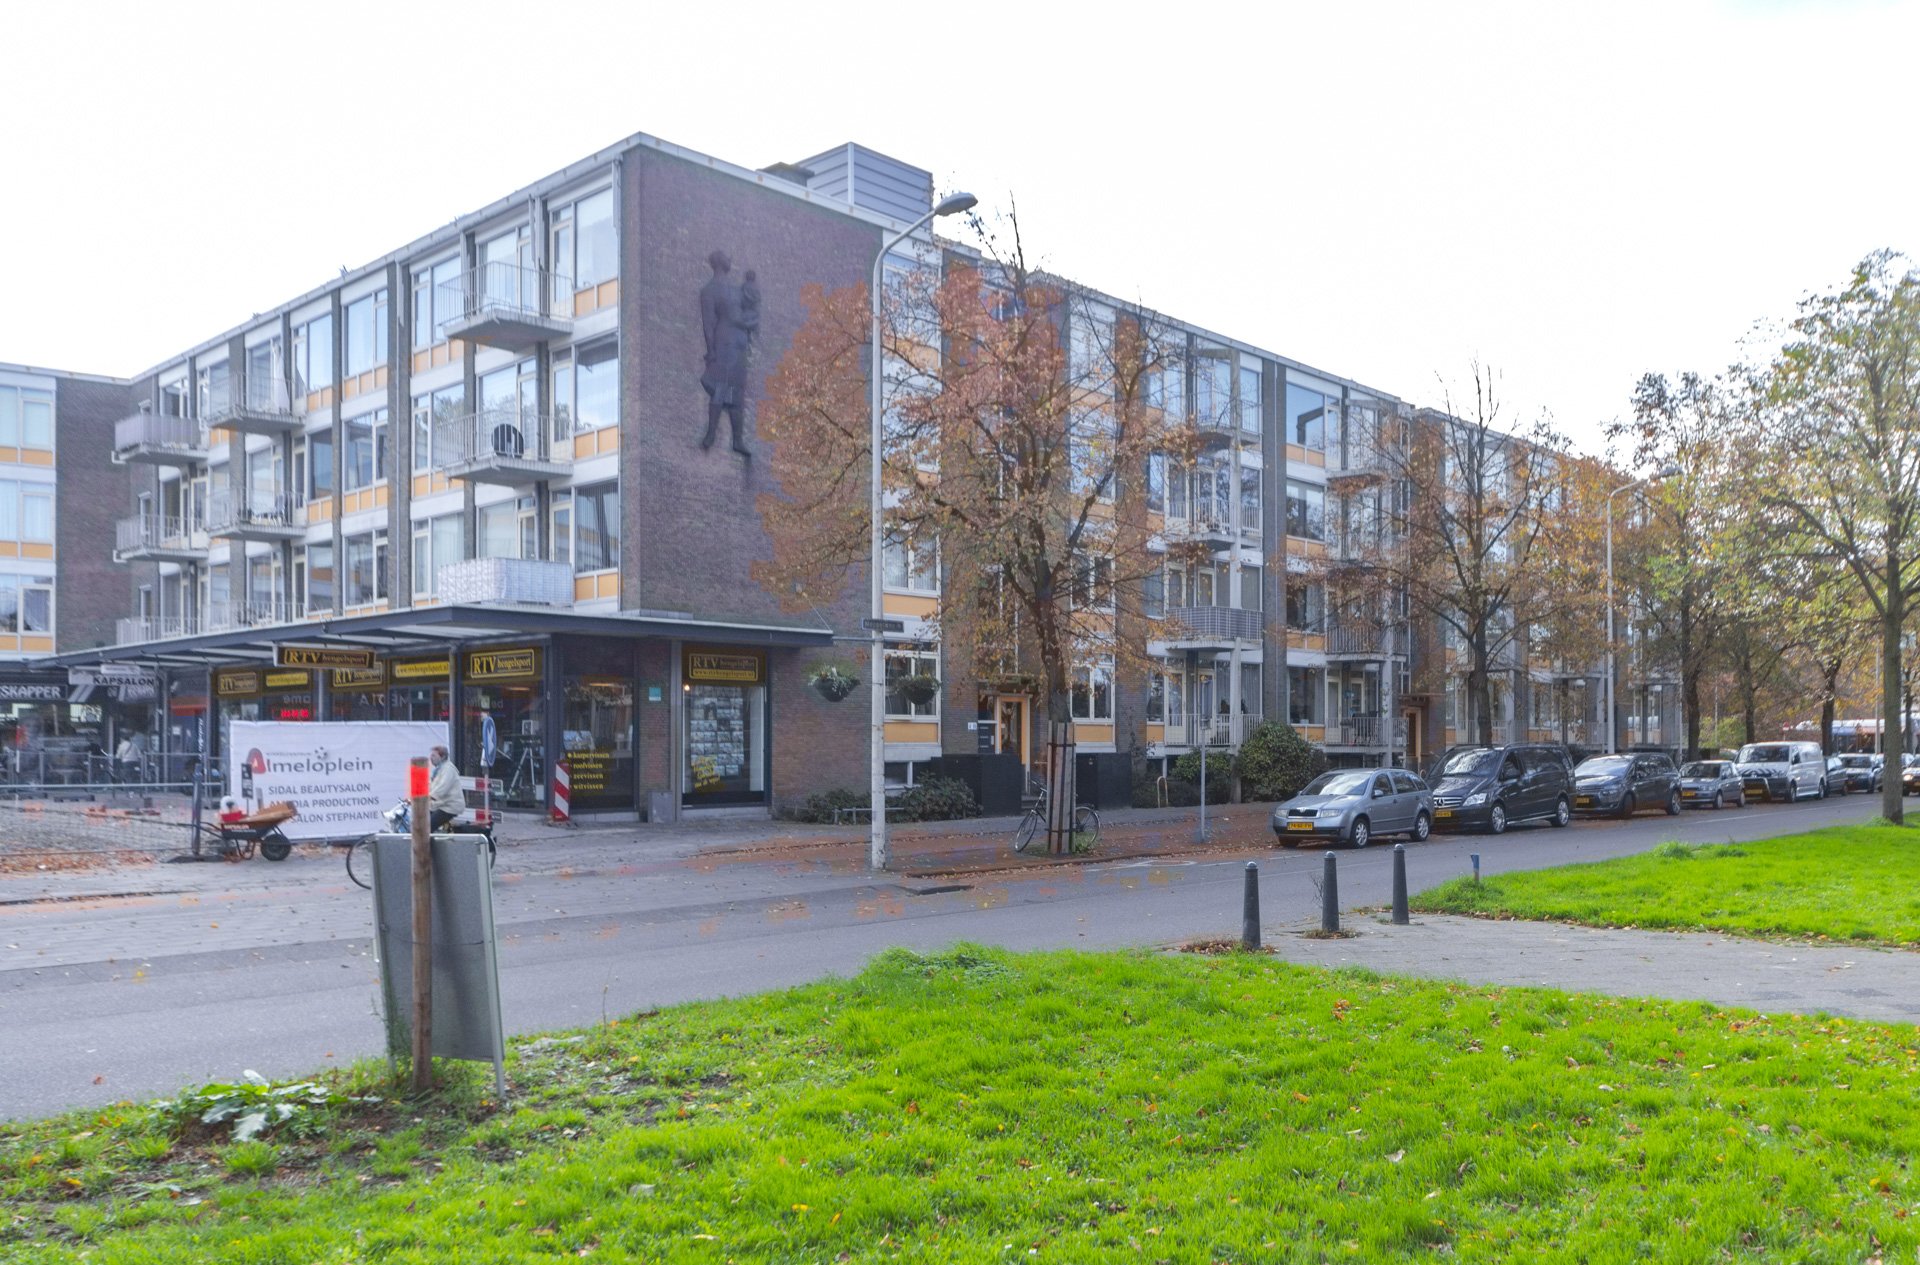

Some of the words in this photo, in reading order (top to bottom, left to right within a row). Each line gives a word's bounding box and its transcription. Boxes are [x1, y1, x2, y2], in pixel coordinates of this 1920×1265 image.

[289, 650, 320, 664] RTV
[693, 657, 718, 668] RTV
[473, 656, 496, 674] RTV
[93, 674, 155, 686] KAPSALON
[268, 785, 298, 796] SIDAL
[300, 783, 371, 795] BEAUTYSALON
[312, 797, 380, 808] PRODUCTIONS
[326, 811, 378, 823] STEPHANIE
